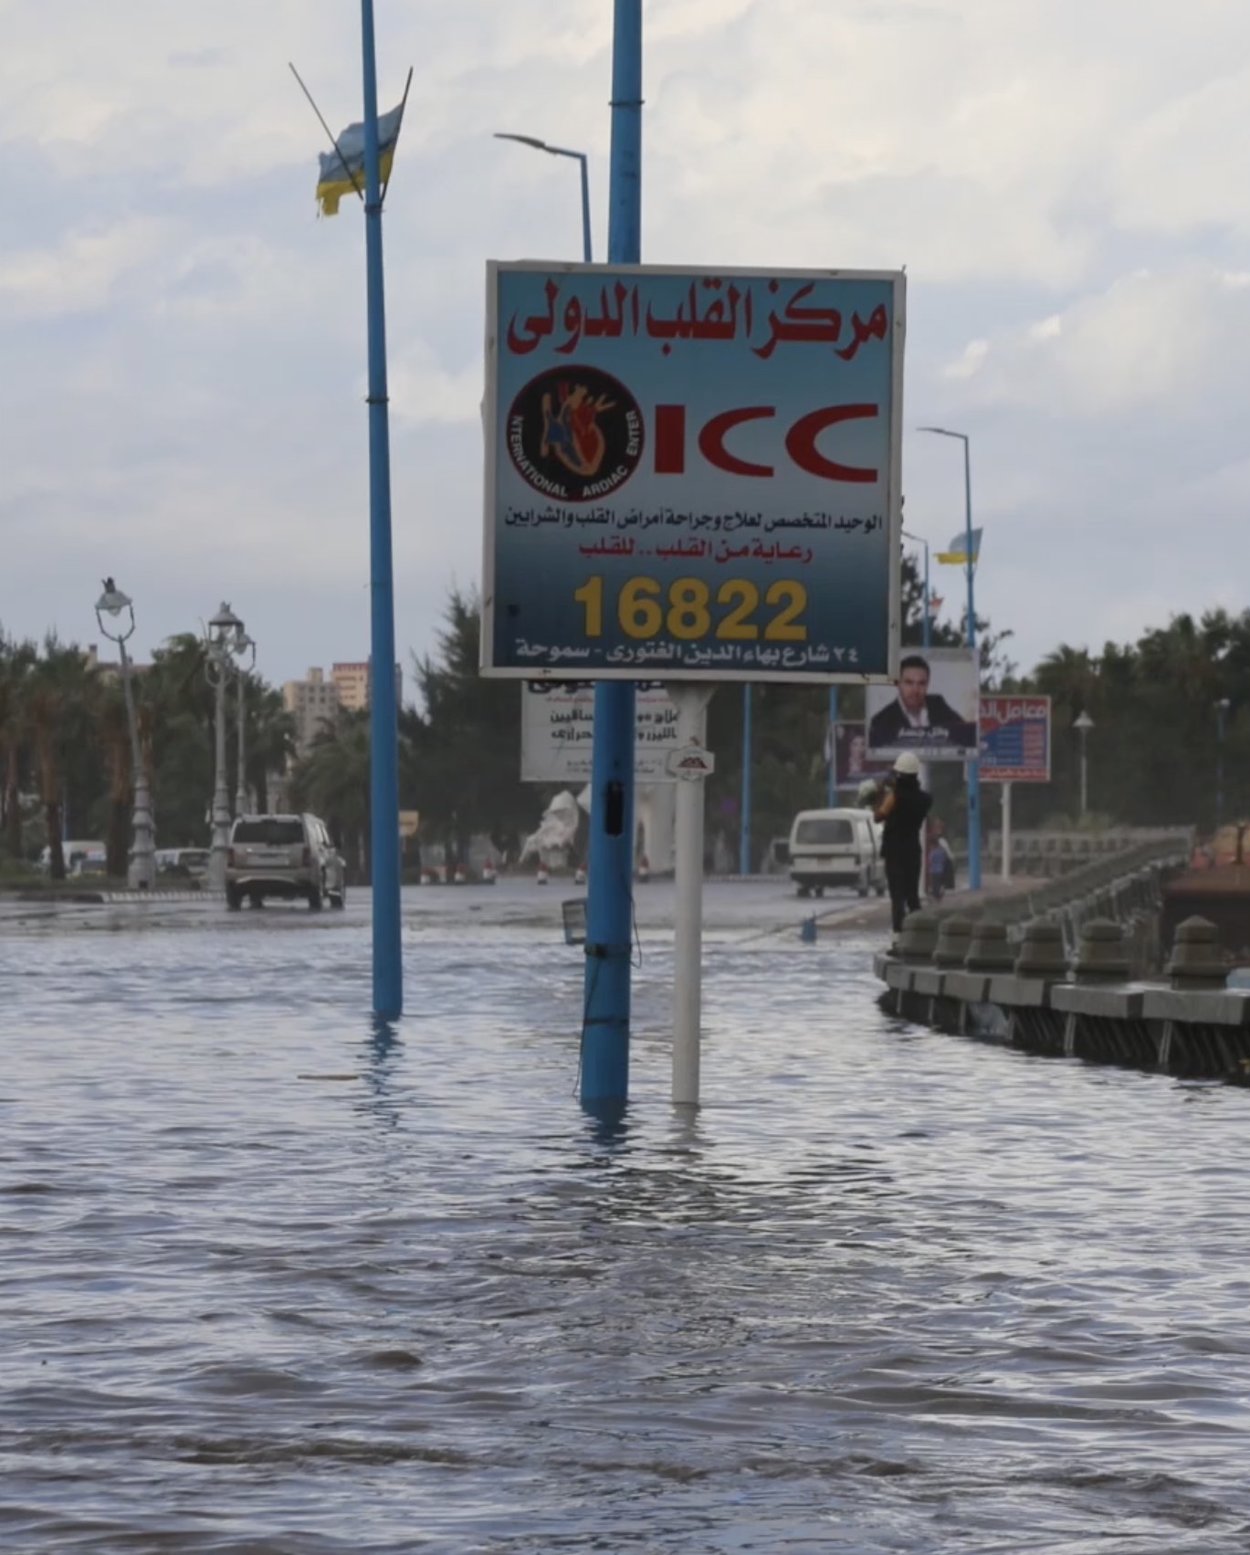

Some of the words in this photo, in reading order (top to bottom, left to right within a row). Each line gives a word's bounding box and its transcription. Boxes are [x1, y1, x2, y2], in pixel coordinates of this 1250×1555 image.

[507, 277, 640, 355] الدولى
[646, 277, 752, 356] القلب
[752, 279, 888, 361] مركز
[654, 403, 878, 483] ICC
[505, 505, 574, 529] والشرايين
[575, 506, 615, 528] القلب
[666, 508, 722, 531] وجراحة
[723, 511, 763, 532] لعلاج
[764, 511, 832, 533] المتخصص
[834, 513, 882, 534] الوحيد
[579, 535, 635, 559] للقلب
[655, 536, 712, 561] القلب
[714, 539, 751, 564] من
[752, 537, 813, 564] رعاية
[575, 575, 808, 641] 16822
[515, 638, 590, 663] سموحة
[684, 643, 741, 665] الدين
[743, 644, 780, 665] بهاء
[782, 643, 830, 667] شارع
[833, 646, 859, 662] ٢٤
